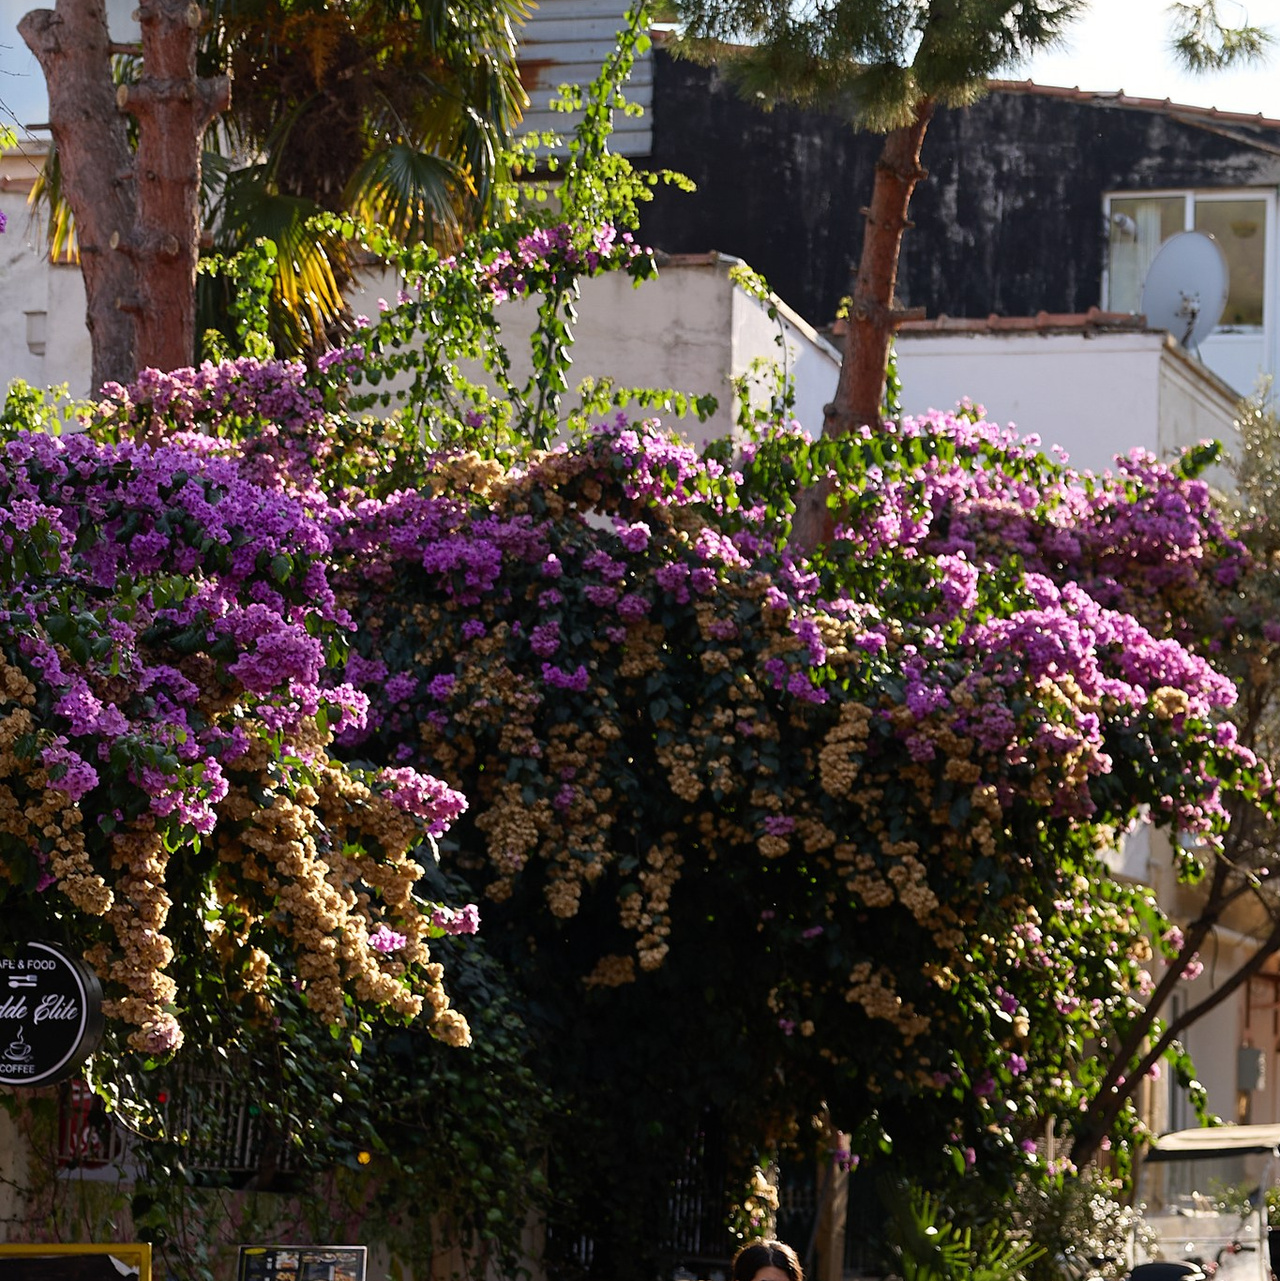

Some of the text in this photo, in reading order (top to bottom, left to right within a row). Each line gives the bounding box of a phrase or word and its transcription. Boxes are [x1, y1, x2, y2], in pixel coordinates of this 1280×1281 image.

[27, 959, 56, 970] FOOD
[34, 994, 78, 1025] Elite
[0, 1063, 35, 1074] COFFEE
